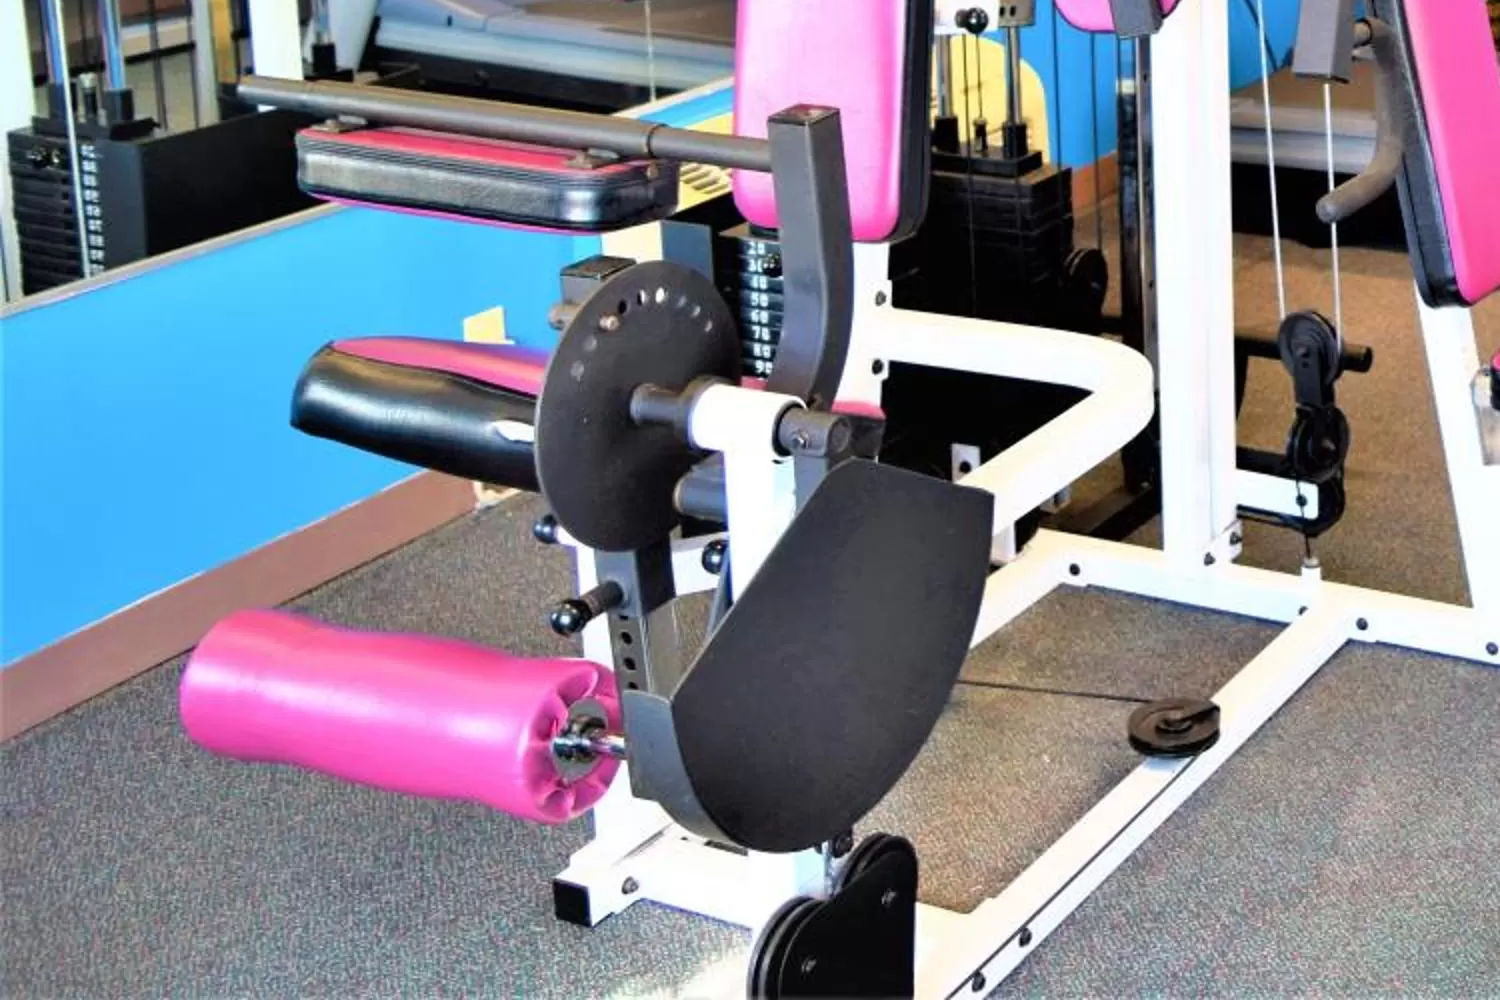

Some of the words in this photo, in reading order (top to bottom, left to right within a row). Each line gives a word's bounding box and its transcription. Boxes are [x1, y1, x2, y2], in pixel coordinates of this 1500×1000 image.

[751, 291, 769, 307] 50
[751, 309, 769, 324] 60
[751, 325, 771, 341] 70
[755, 360, 773, 375] 90
